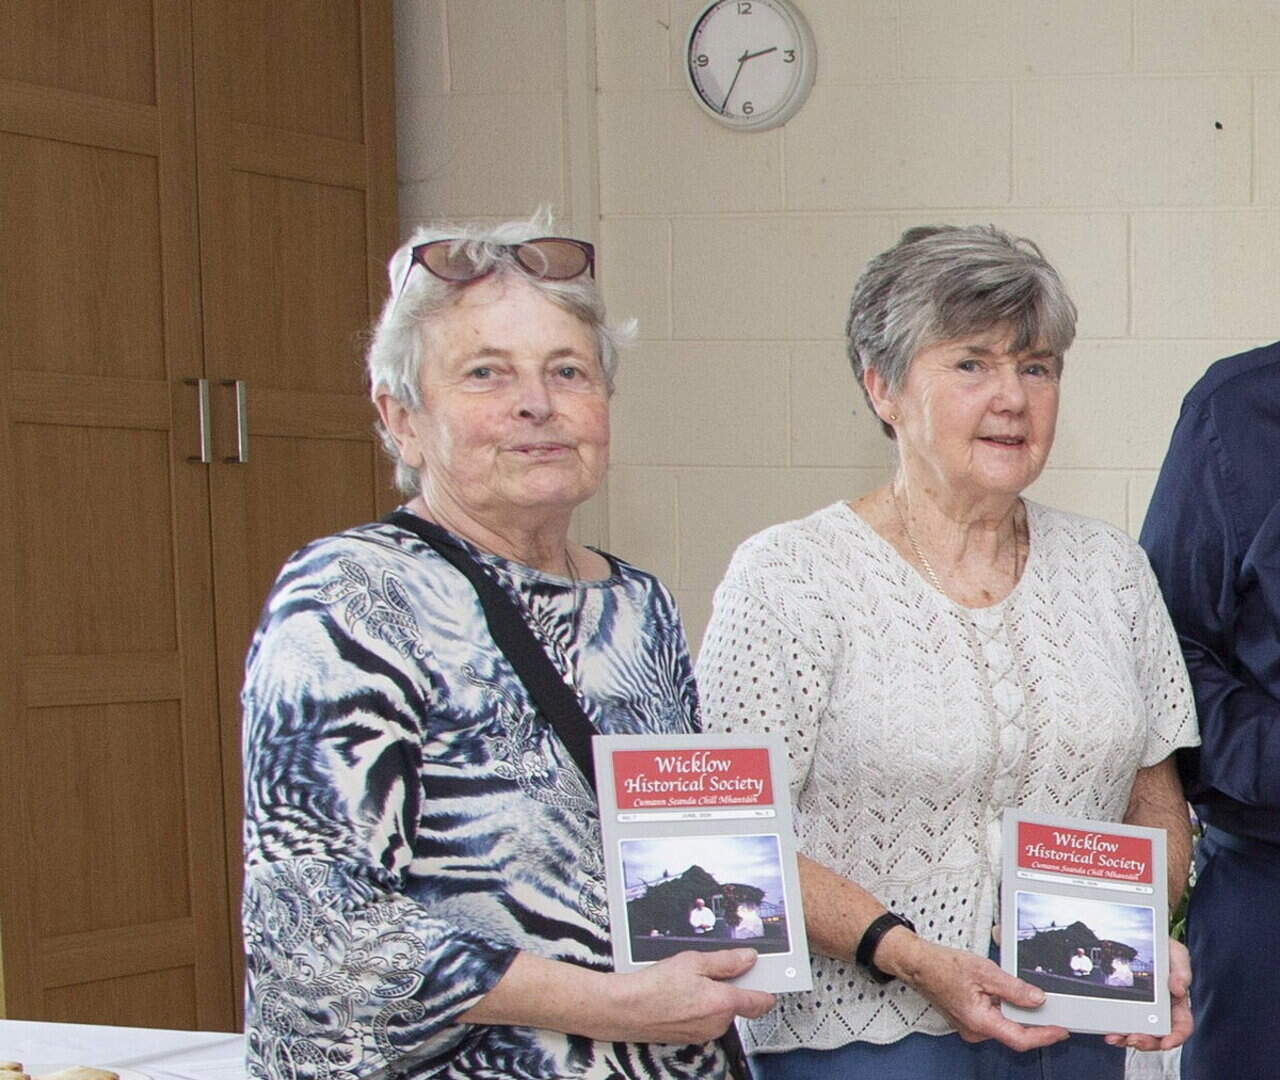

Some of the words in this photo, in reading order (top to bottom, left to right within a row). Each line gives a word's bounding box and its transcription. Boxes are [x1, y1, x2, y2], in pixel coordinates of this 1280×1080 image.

[737, 2, 753, 15] 12
[696, 54, 709, 68] 9
[783, 49, 796, 64] 3
[742, 101, 754, 115] 6
[654, 751, 732, 774] Wicklow
[624, 771, 707, 793] Historical
[709, 776, 764, 799] Society
[1053, 831, 1119, 853] Wicklow
[1025, 842, 1097, 865] Historical
[1097, 854, 1145, 878] Society
